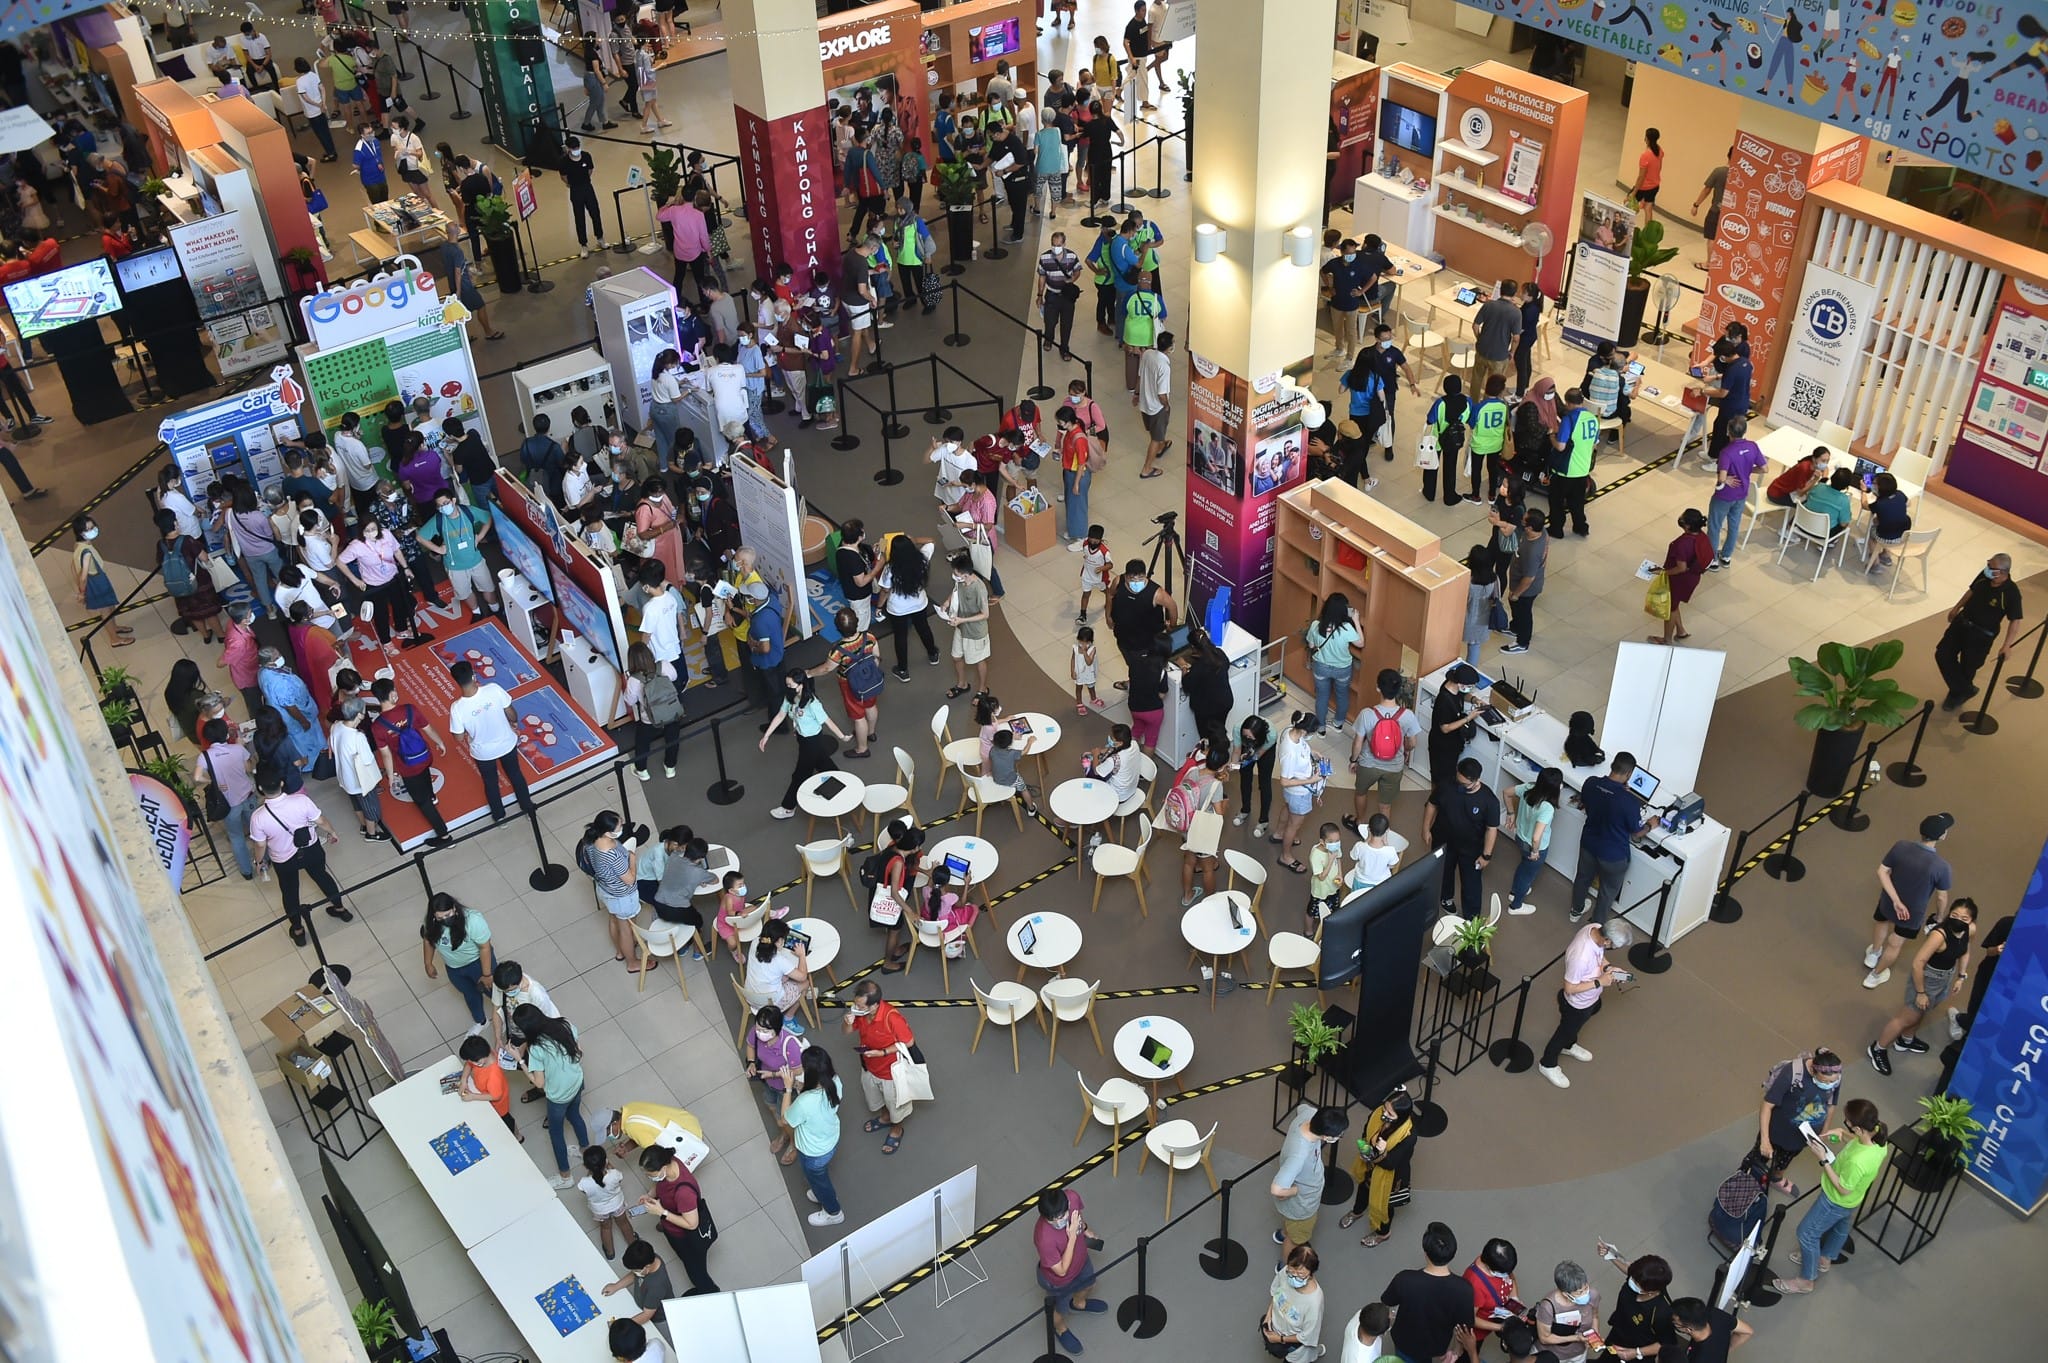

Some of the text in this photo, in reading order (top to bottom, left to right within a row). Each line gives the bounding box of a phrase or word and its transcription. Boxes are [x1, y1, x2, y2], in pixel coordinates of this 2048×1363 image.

[819, 25, 891, 61] EXPLORE
[1567, 17, 1653, 56] VEGETABLES
[1485, 94, 1554, 124] LIONS BEFRIENDERS
[1495, 86, 1557, 113] IM-OK DEVICE BY
[1994, 88, 2048, 115] BREAD
[1864, 117, 1892, 140] egg
[1917, 126, 2017, 176] SPORTS
[1737, 157, 1757, 177] YOGA
[749, 120, 774, 279] KAMPONG CHAI
[793, 120, 819, 279] KAMPONG CHAI
[1765, 201, 1796, 218] VIBRANT
[185, 228, 235, 247] WHAT MAKES US
[1723, 219, 1748, 236] BEDOK
[191, 243, 214, 254] SMART
[214, 235, 239, 247] NATION?
[1716, 239, 1732, 250] FOOD
[309, 267, 434, 323] Google
[418, 310, 445, 328] kind
[1744, 313, 1759, 325] ECO
[1804, 288, 1857, 330] LIONS BEFRIENDERS
[1805, 328, 1842, 348] SINGAPORE
[319, 375, 372, 401] It's Cool
[1191, 391, 1211, 407] FESTIVAL
[242, 391, 280, 410] care
[342, 396, 358, 409] Be
[1191, 382, 1244, 418] DIGITAL FOR LIFE
[1251, 400, 1279, 417] DIGITAL
[1484, 411, 1504, 429] LB
[1582, 419, 1597, 441] LB
[187, 452, 204, 460] PARENT
[1192, 491, 1206, 503] MAKE
[1210, 501, 1234, 520] DIFFERENCE
[1193, 498, 1234, 528] WITH DATA FOR ALL
[472, 702, 493, 717] Google
[1974, 1024, 2048, 1173] CHAI CHEE
